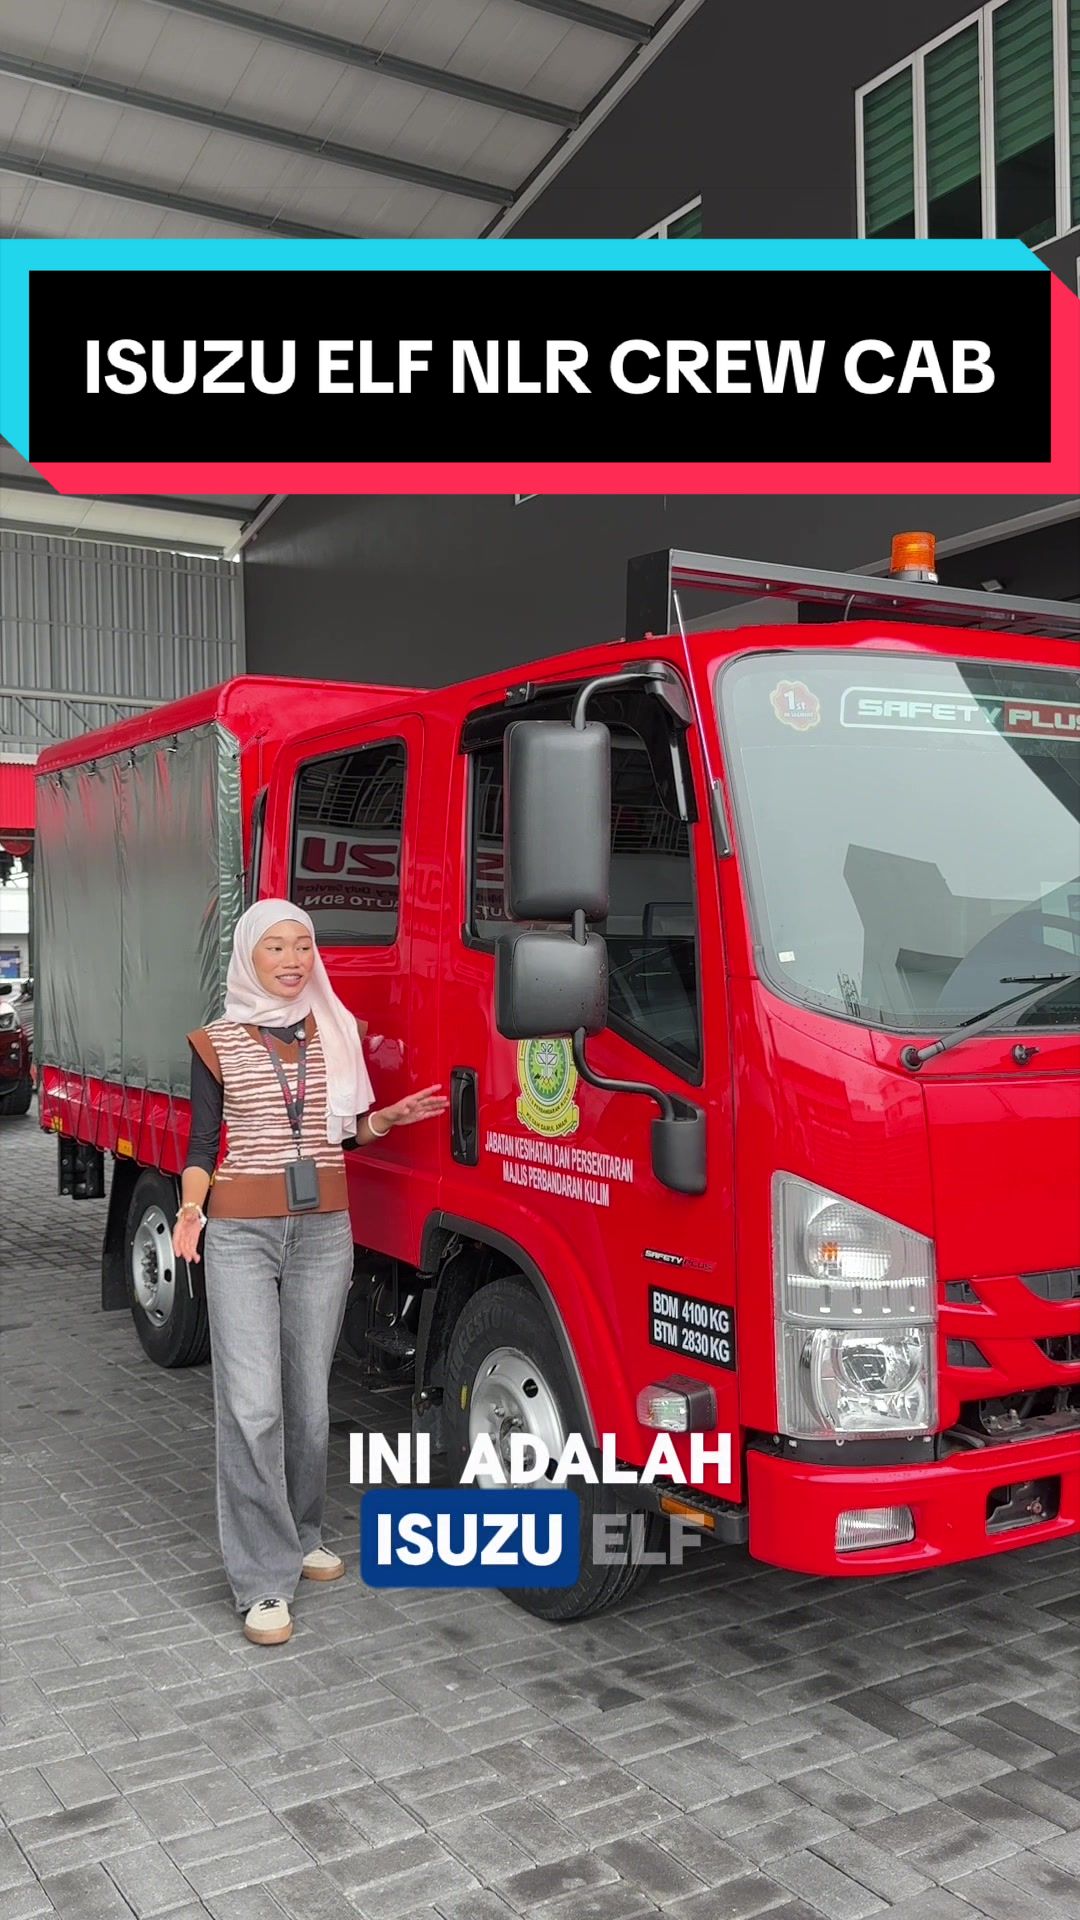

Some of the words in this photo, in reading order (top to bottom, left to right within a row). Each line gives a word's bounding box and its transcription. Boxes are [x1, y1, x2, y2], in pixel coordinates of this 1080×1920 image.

[858, 699, 1002, 724] SAFETY
[1008, 708, 1080, 731] PLU
[485, 1131, 515, 1158] JABATAN
[514, 1137, 552, 1165] KESIHATAN
[554, 1144, 570, 1169] DAN
[571, 1148, 634, 1183] PERSEKITARAN
[503, 1160, 527, 1187] MAJLIS
[528, 1166, 583, 1200] PERBANDARAN
[584, 1179, 610, 1207] KULIM
[645, 1249, 683, 1265] SAFETY
[653, 1291, 679, 1319] BDM
[681, 1300, 708, 1328] 4100
[709, 1307, 729, 1334] KG
[653, 1319, 678, 1347] BTM
[681, 1328, 709, 1356] 2830
[710, 1336, 730, 1362] KG
